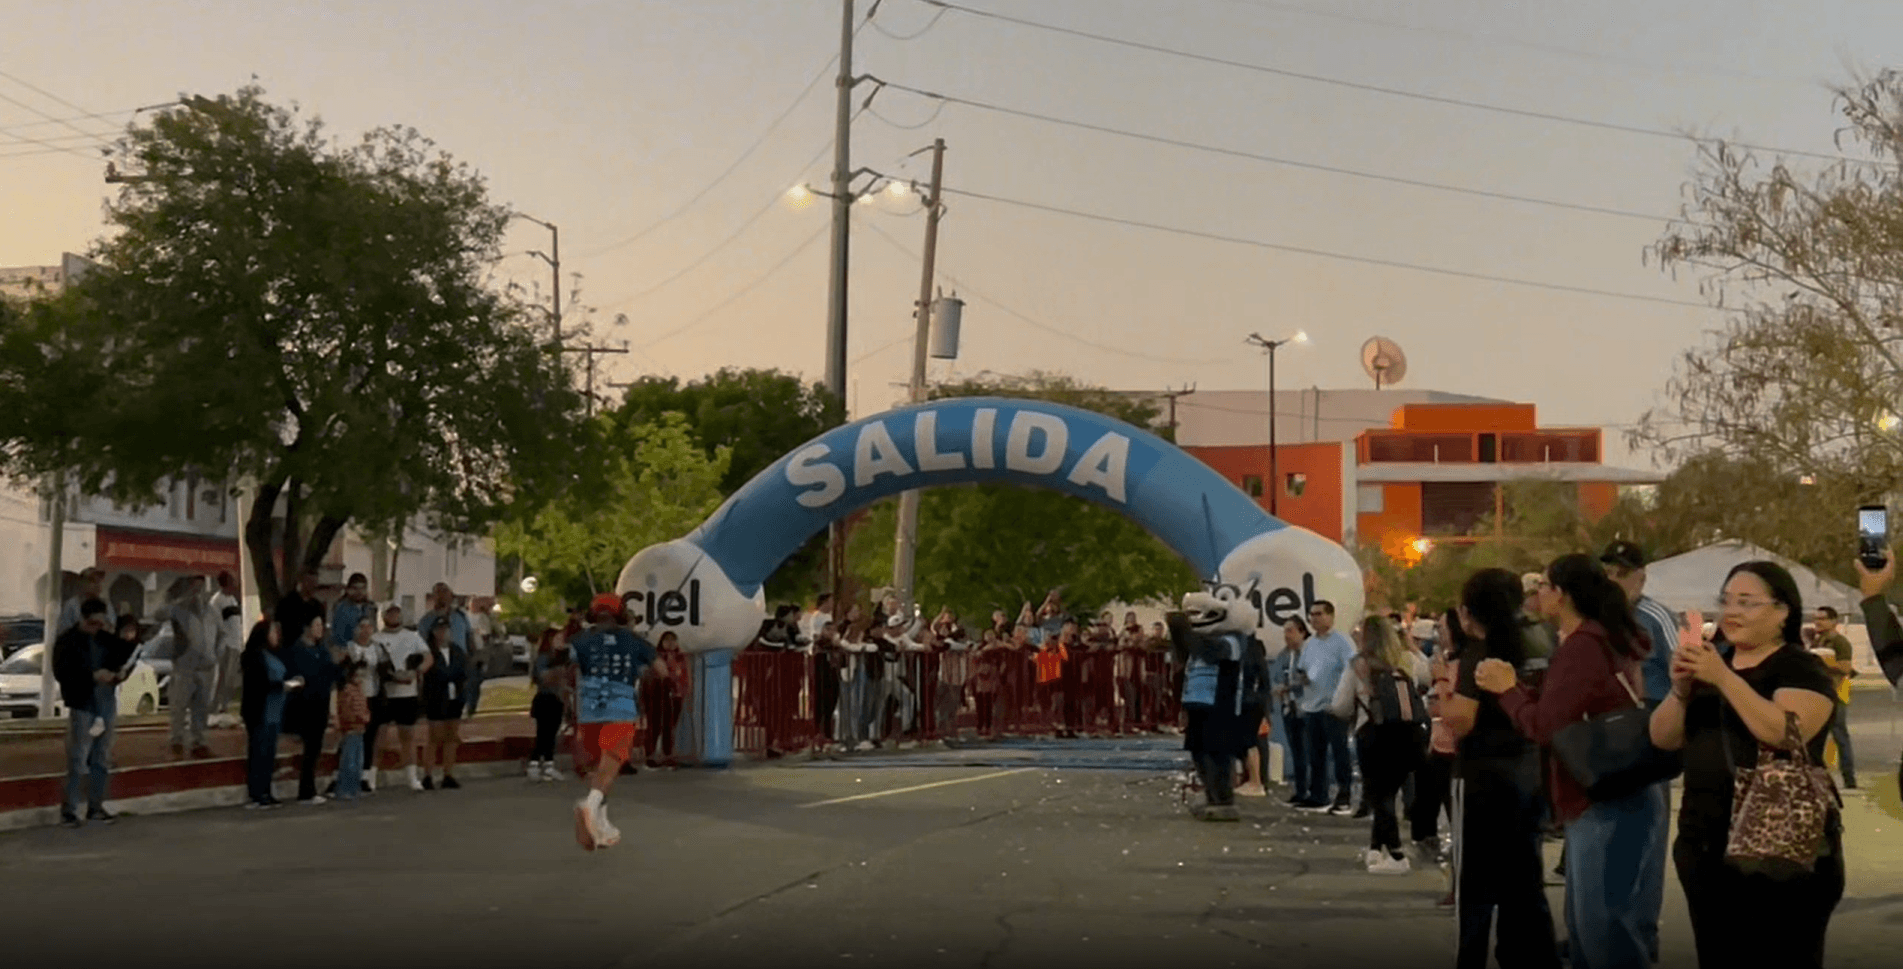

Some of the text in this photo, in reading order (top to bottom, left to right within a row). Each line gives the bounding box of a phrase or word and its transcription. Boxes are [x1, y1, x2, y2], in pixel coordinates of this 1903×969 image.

[784, 407, 1130, 508] SALIDA
[620, 573, 700, 627] ciel
[1248, 571, 1315, 628] iel
